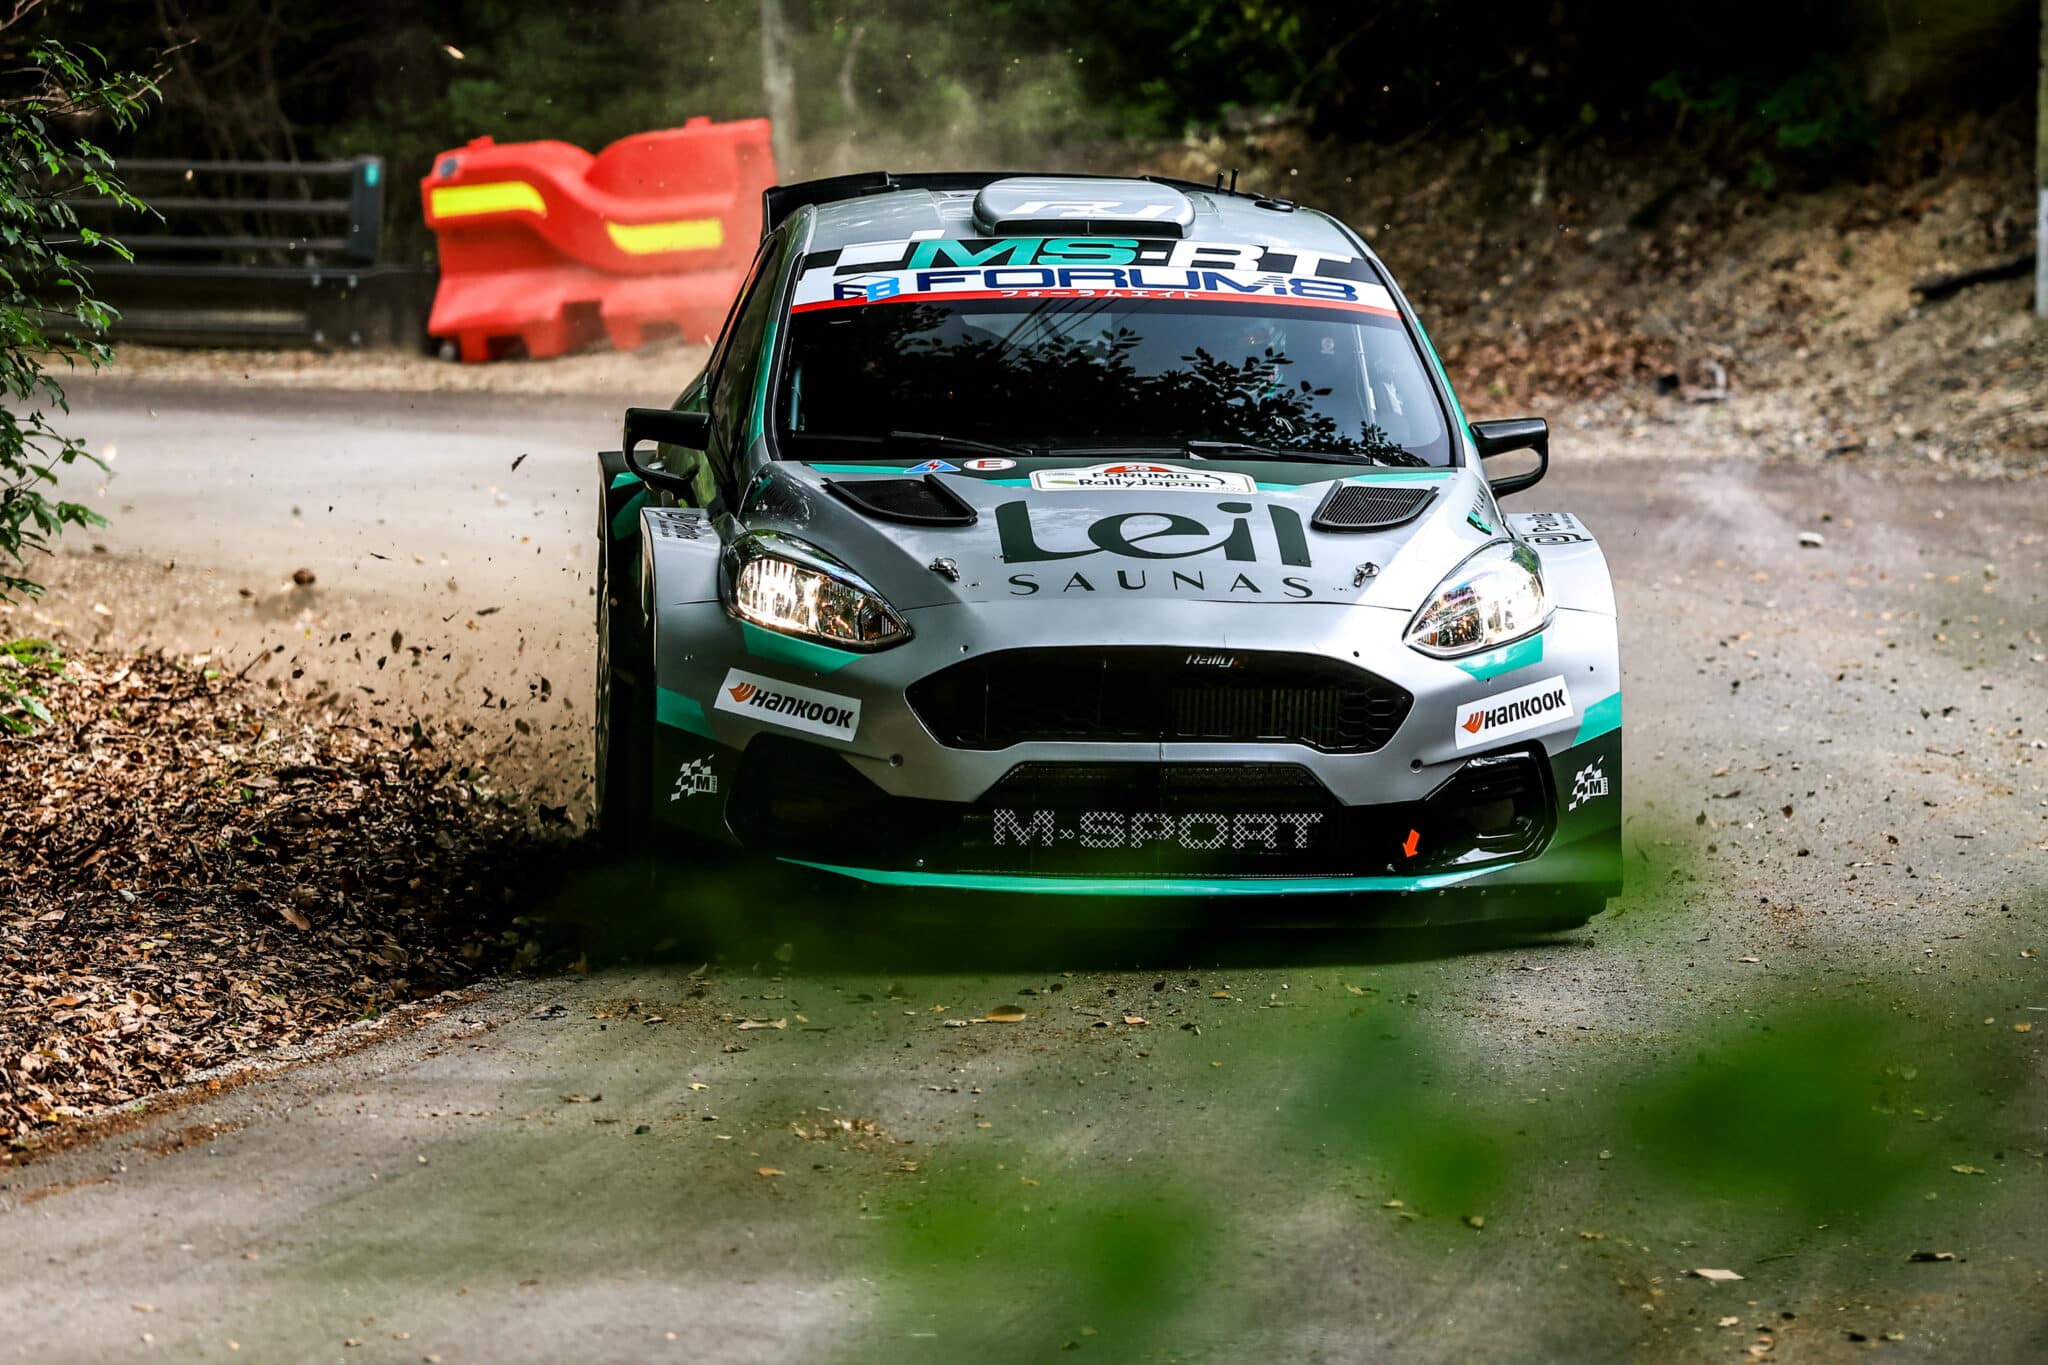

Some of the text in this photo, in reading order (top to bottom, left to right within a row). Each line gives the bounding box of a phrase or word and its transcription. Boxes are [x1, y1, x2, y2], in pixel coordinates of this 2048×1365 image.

[916, 267, 1359, 302] FORUM8
[1000, 290, 1199, 299] フォーラムエイト
[1092, 472, 1190, 480] FORUM8
[994, 500, 1312, 568] Leil
[1008, 570, 1313, 599] SAUNAS
